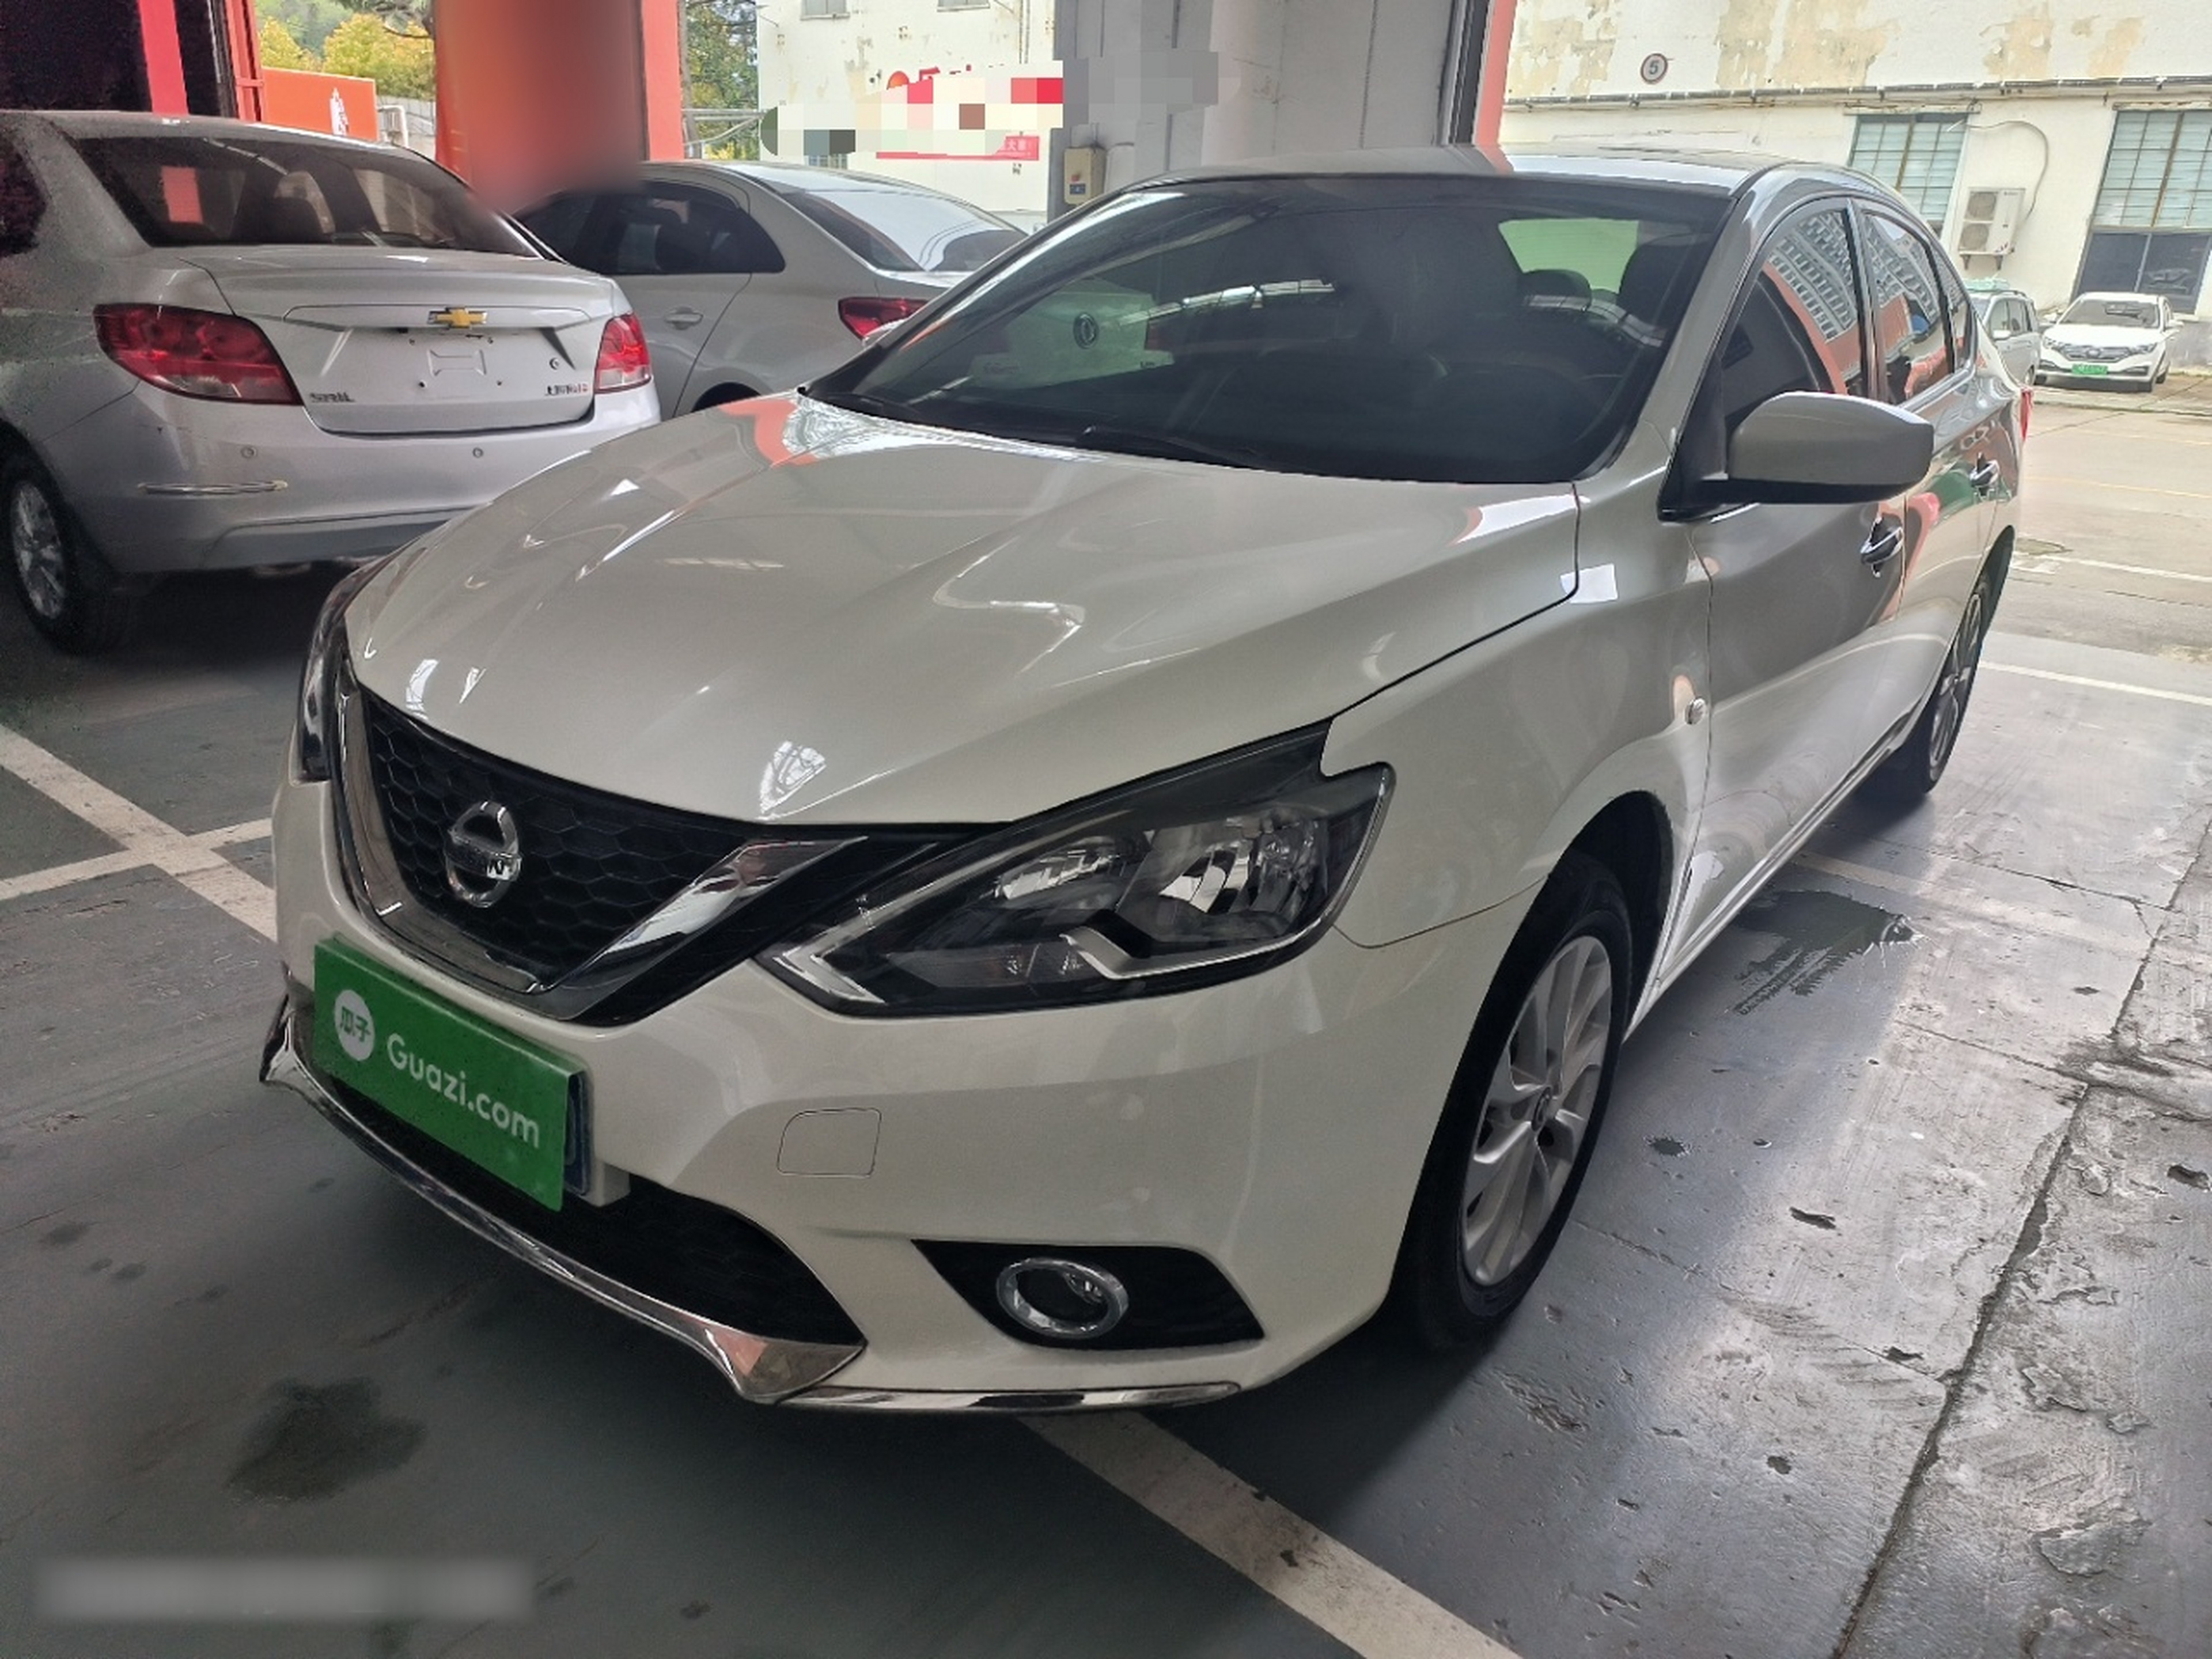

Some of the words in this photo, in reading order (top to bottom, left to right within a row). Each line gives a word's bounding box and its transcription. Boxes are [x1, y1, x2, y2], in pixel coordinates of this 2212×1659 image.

[1649, 60, 1659, 75] 5
[340, 1006, 372, 1043] 瓜子
[387, 1033, 539, 1148] Guazi.com
